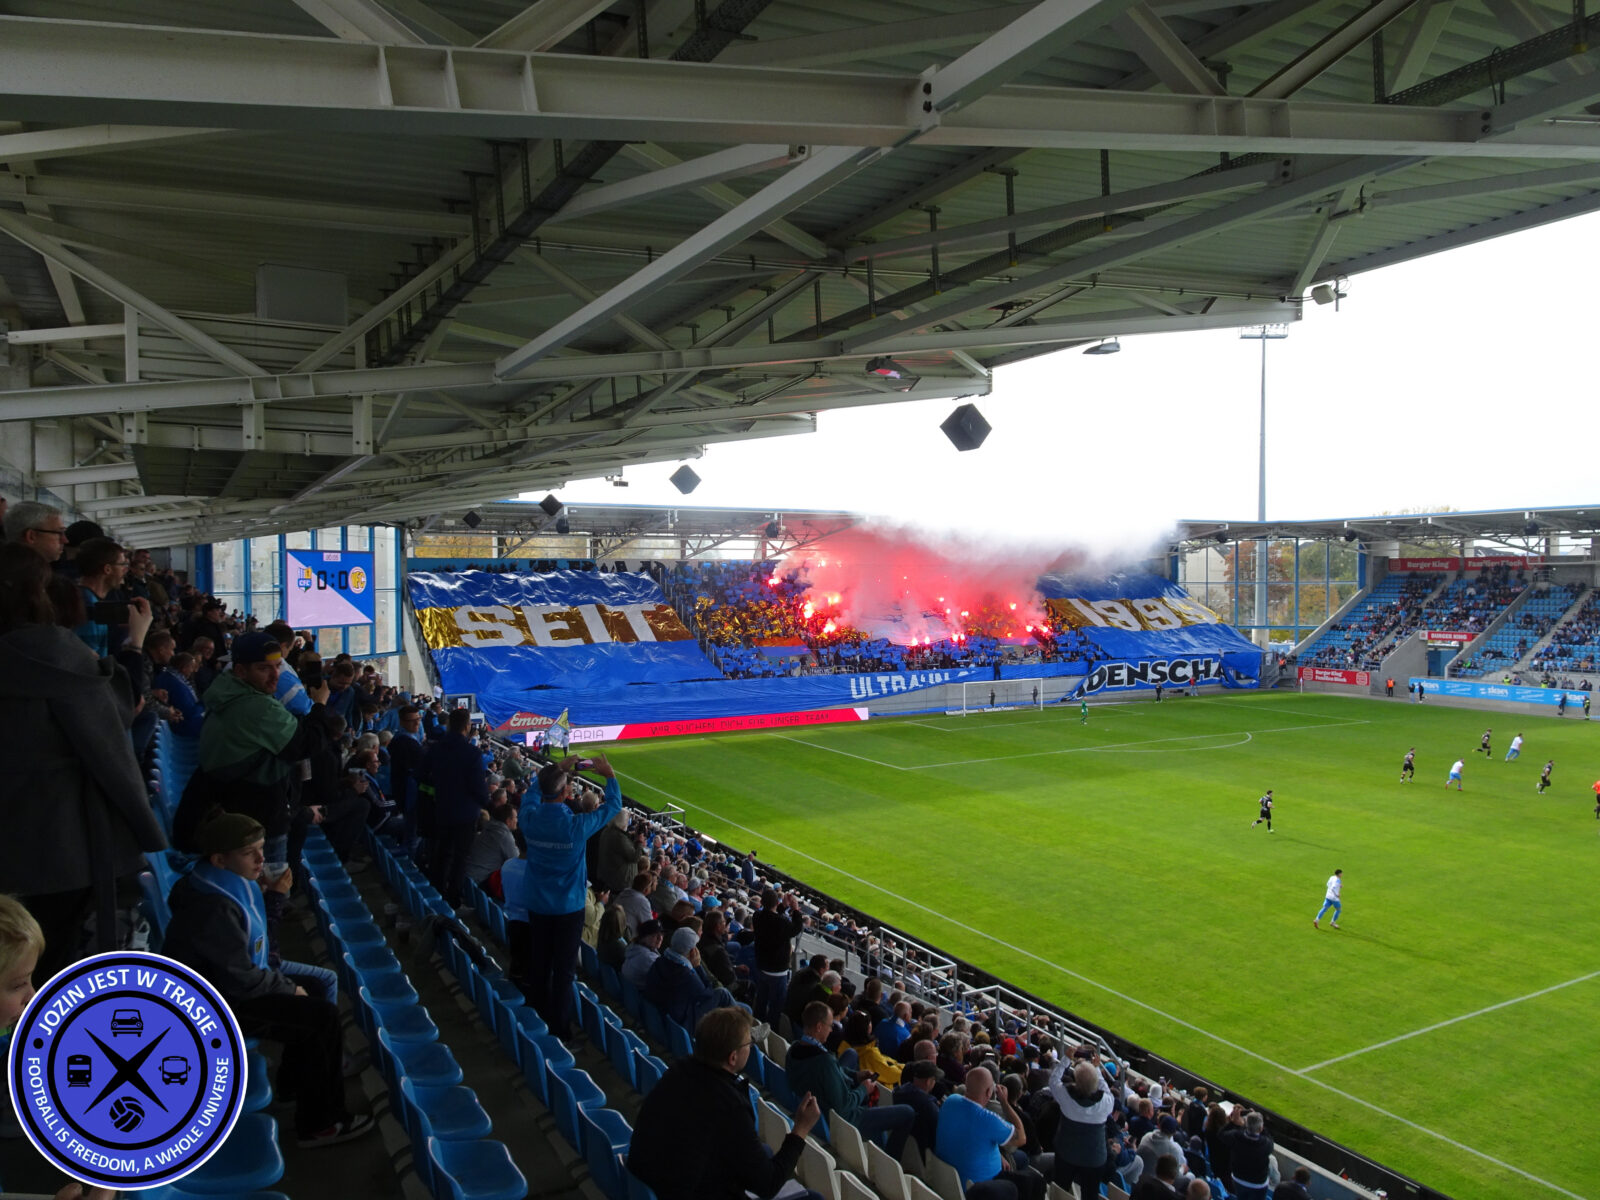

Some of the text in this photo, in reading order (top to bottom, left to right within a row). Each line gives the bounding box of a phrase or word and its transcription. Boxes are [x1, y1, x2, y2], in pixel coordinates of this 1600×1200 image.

[1407, 561, 1431, 569] Burger
[1432, 560, 1450, 569] King
[317, 571, 348, 590] 0:0
[453, 604, 661, 648] SEIT
[510, 713, 553, 727] Emons
[805, 712, 829, 721] TEAM
